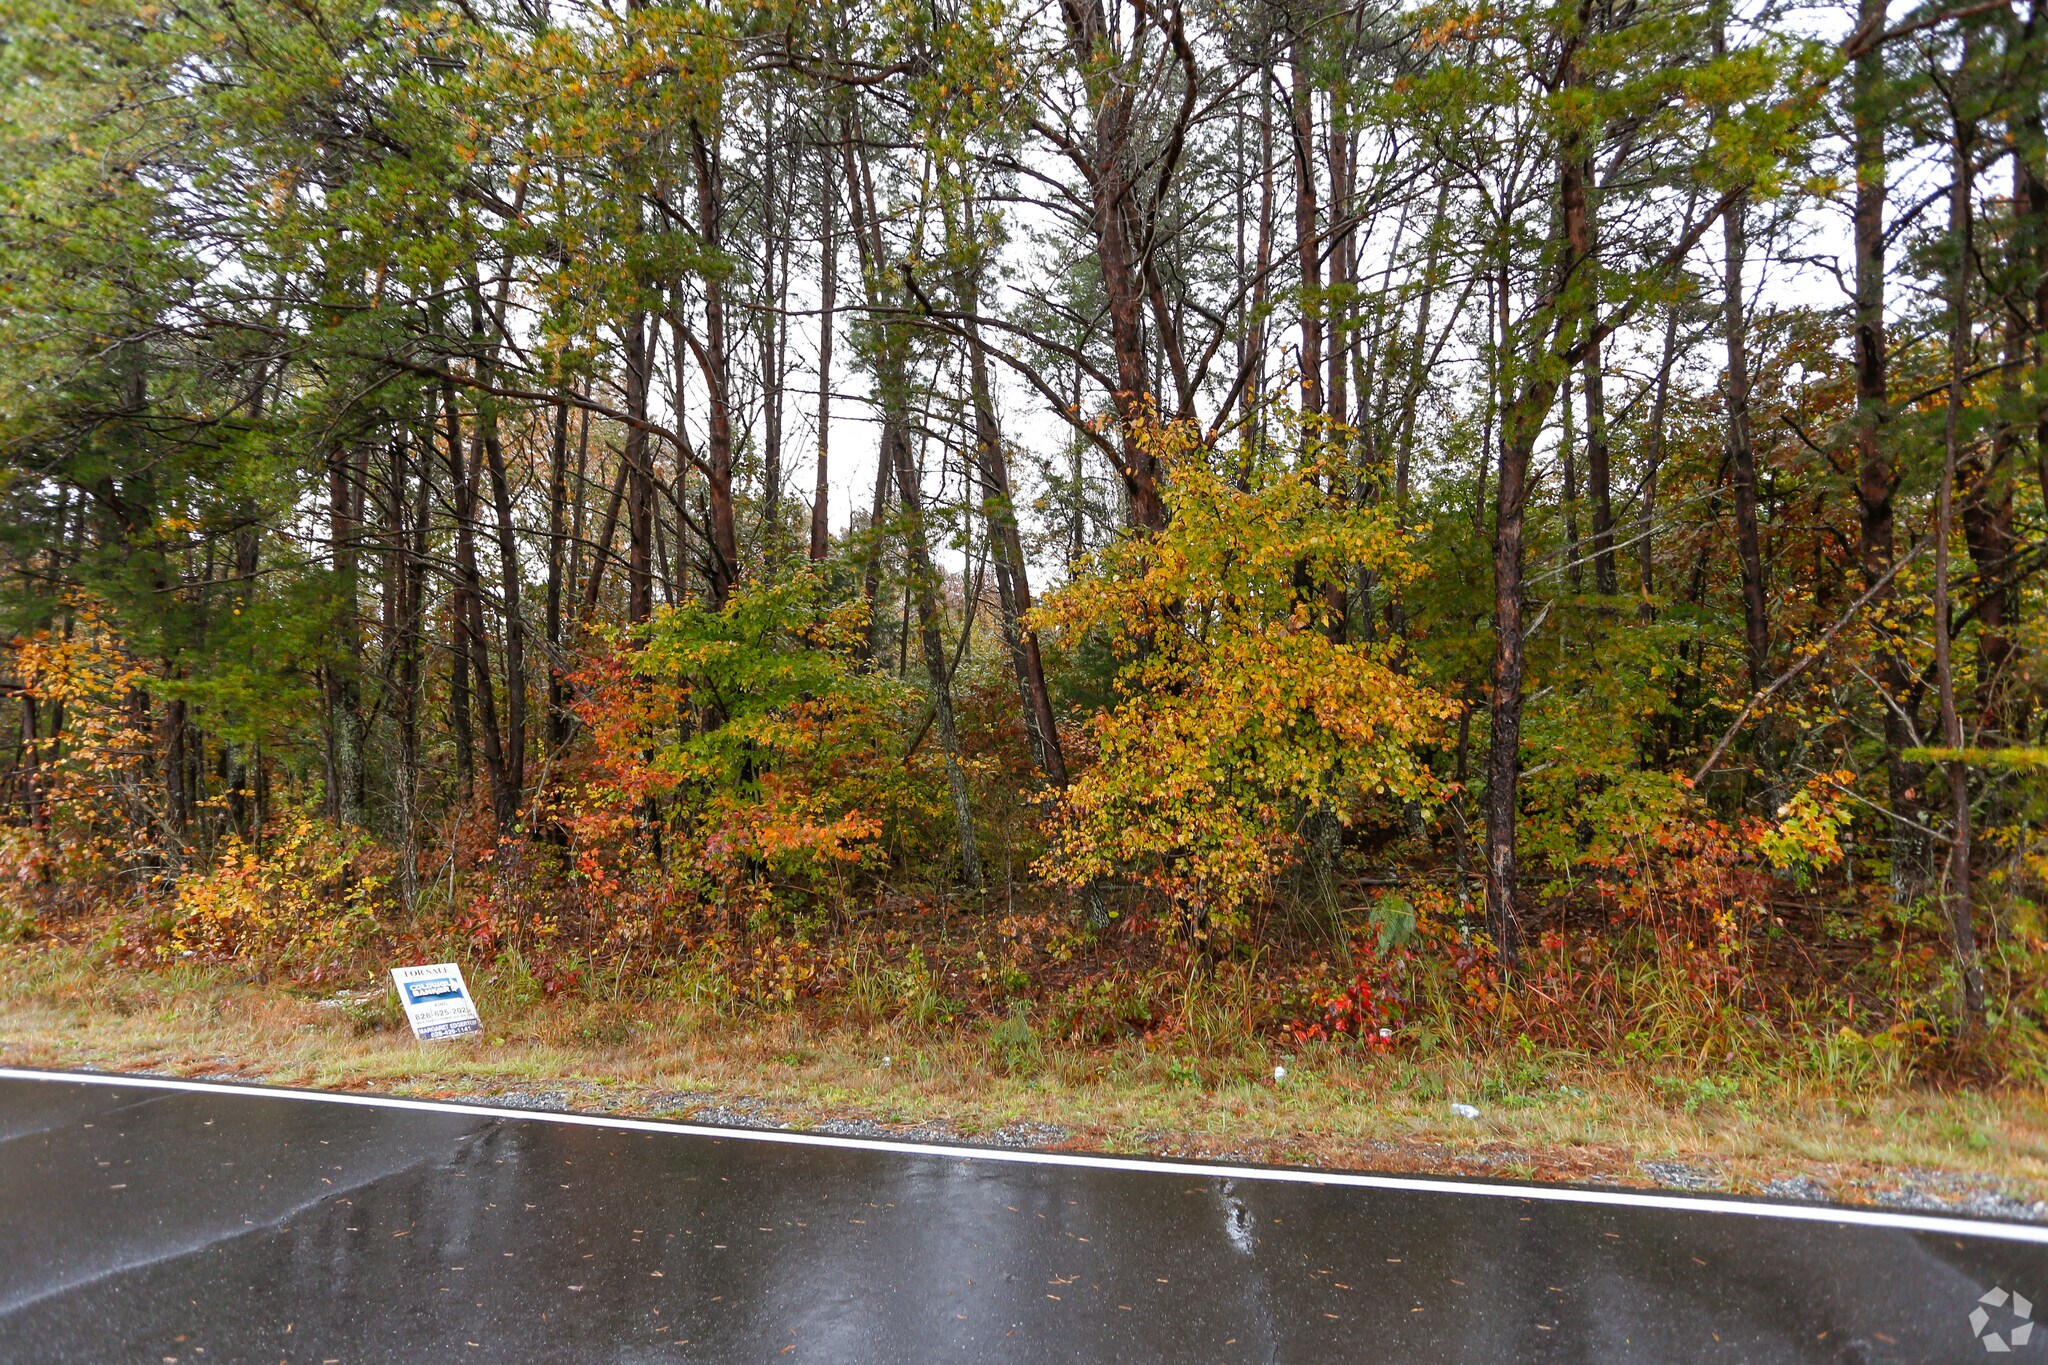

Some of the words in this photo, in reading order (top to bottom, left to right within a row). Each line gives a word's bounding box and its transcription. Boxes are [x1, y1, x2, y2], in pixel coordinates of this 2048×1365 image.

[404, 969, 424, 978] FOR
[412, 986, 450, 997] BANKER
[418, 1024, 448, 1034] MARGARET
